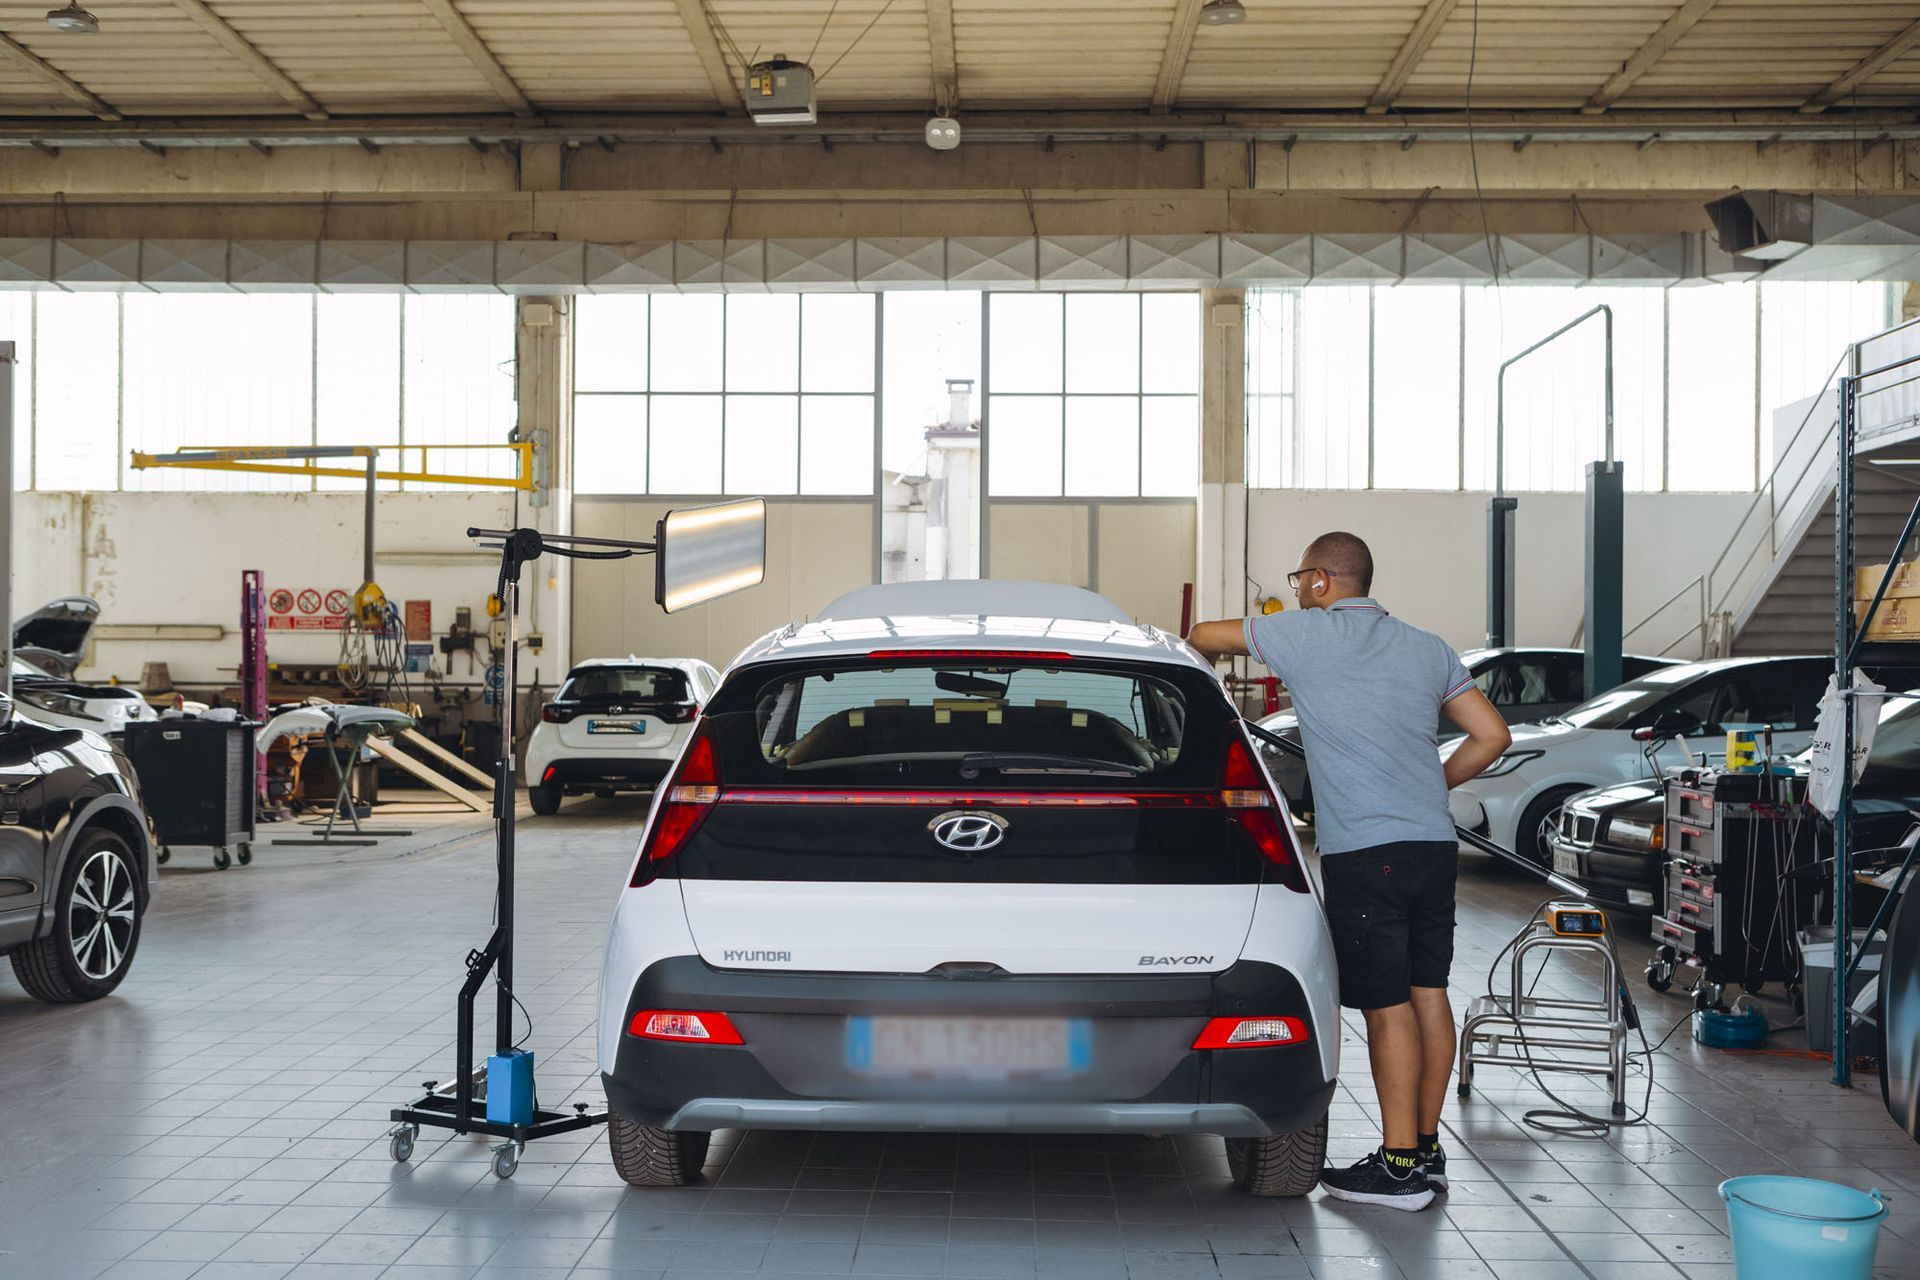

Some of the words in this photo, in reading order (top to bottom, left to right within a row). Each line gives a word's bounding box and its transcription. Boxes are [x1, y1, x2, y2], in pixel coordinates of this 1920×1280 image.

[723, 950, 791, 962] HYUNDAI
[1138, 955, 1214, 966] BAYON
[1385, 1151, 1416, 1168] WORK
